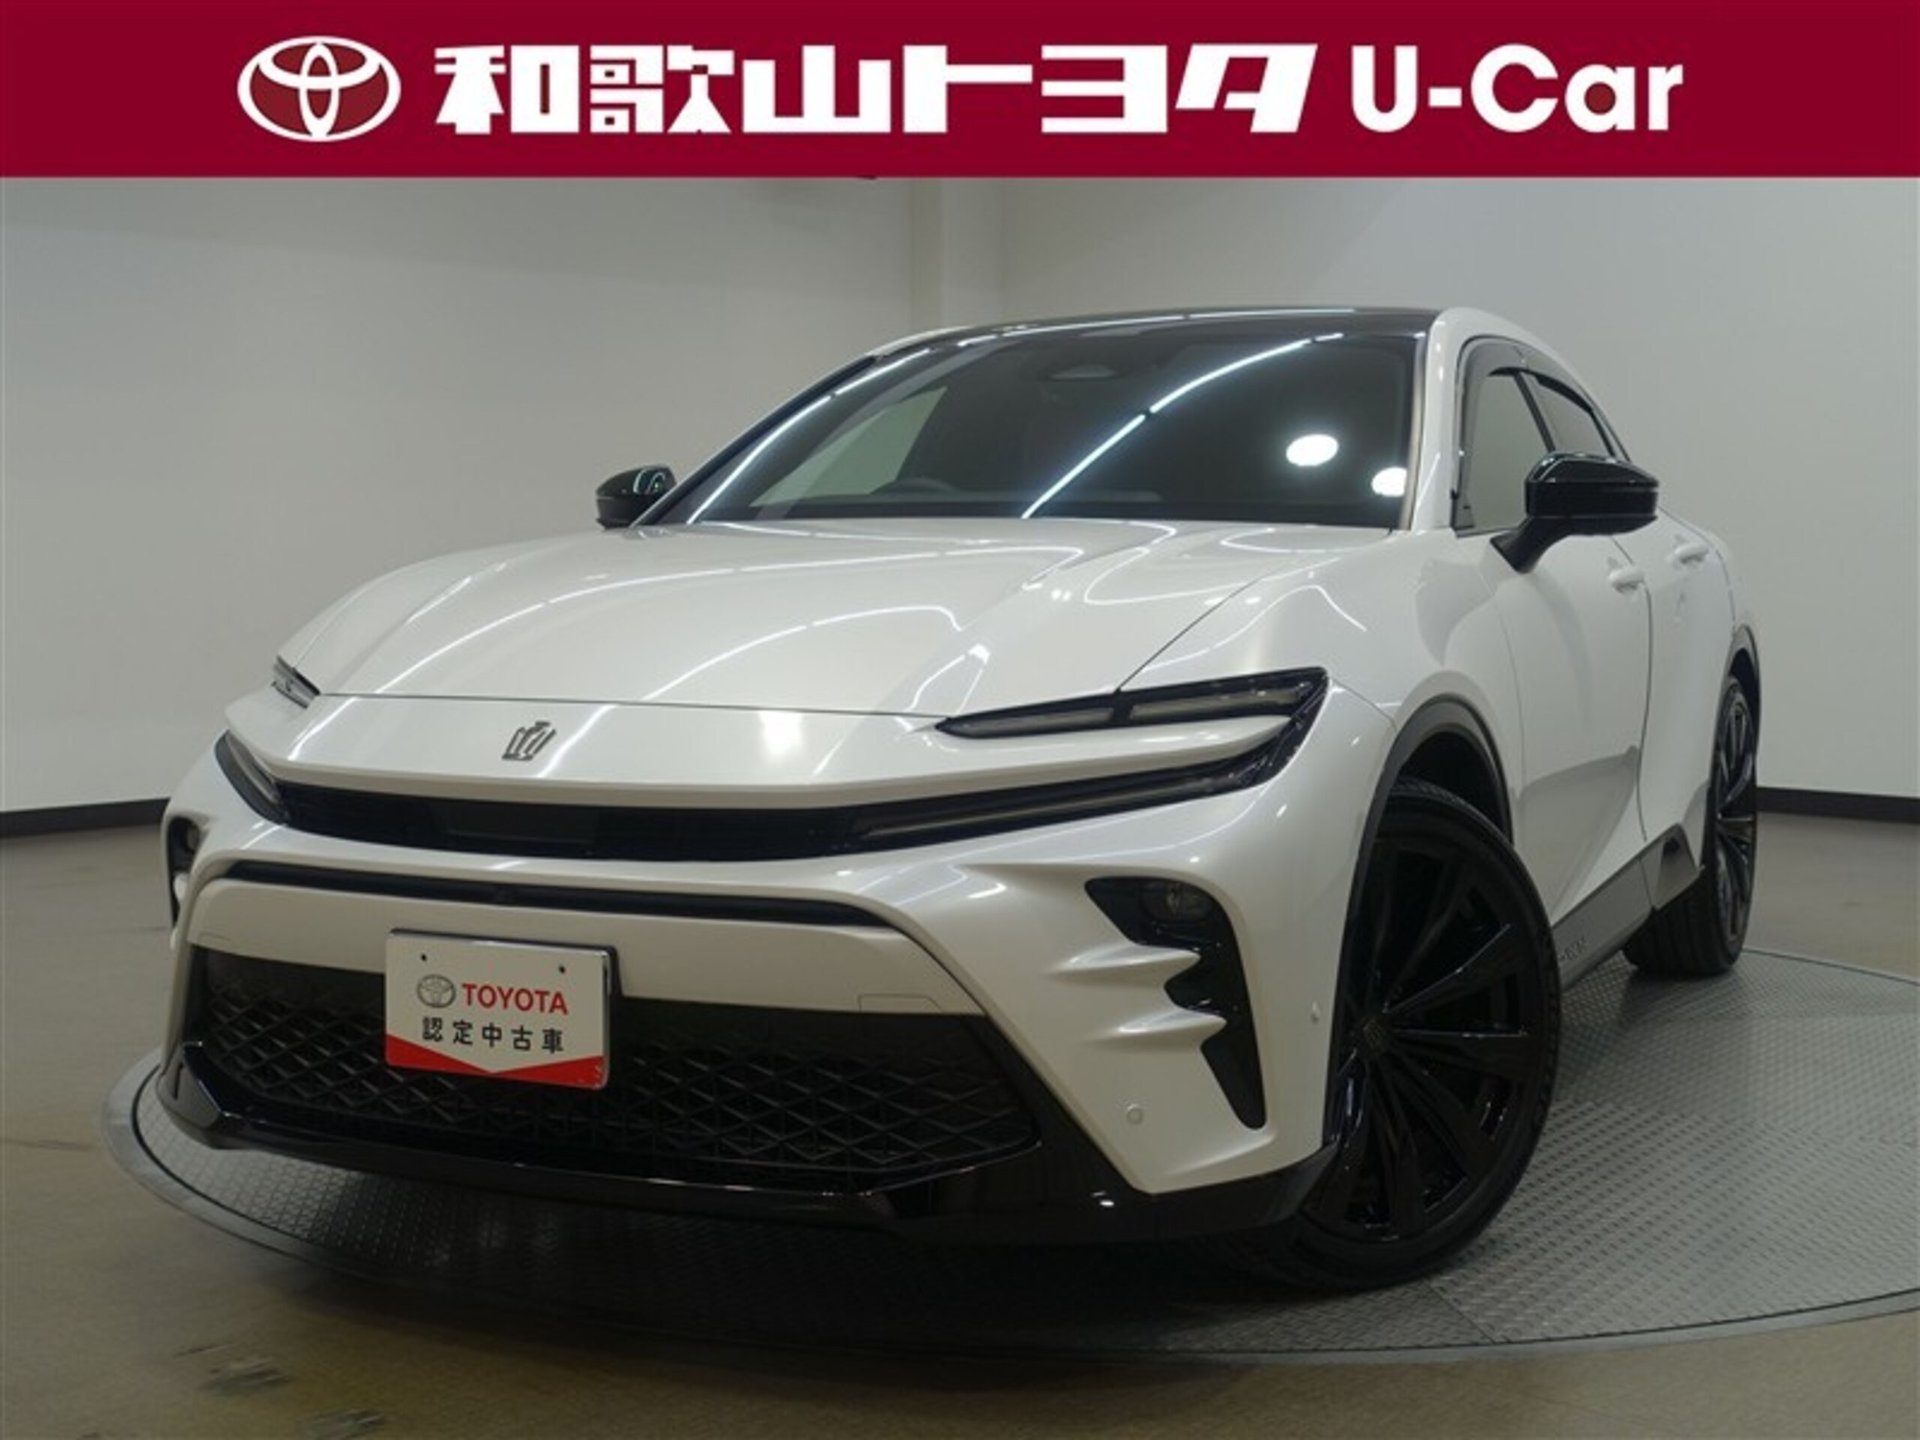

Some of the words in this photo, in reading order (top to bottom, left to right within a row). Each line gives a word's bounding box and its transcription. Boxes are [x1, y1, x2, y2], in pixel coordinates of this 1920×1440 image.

[462, 983, 568, 1015] TOYOTA
[422, 1016, 564, 1054] 認定中古車
